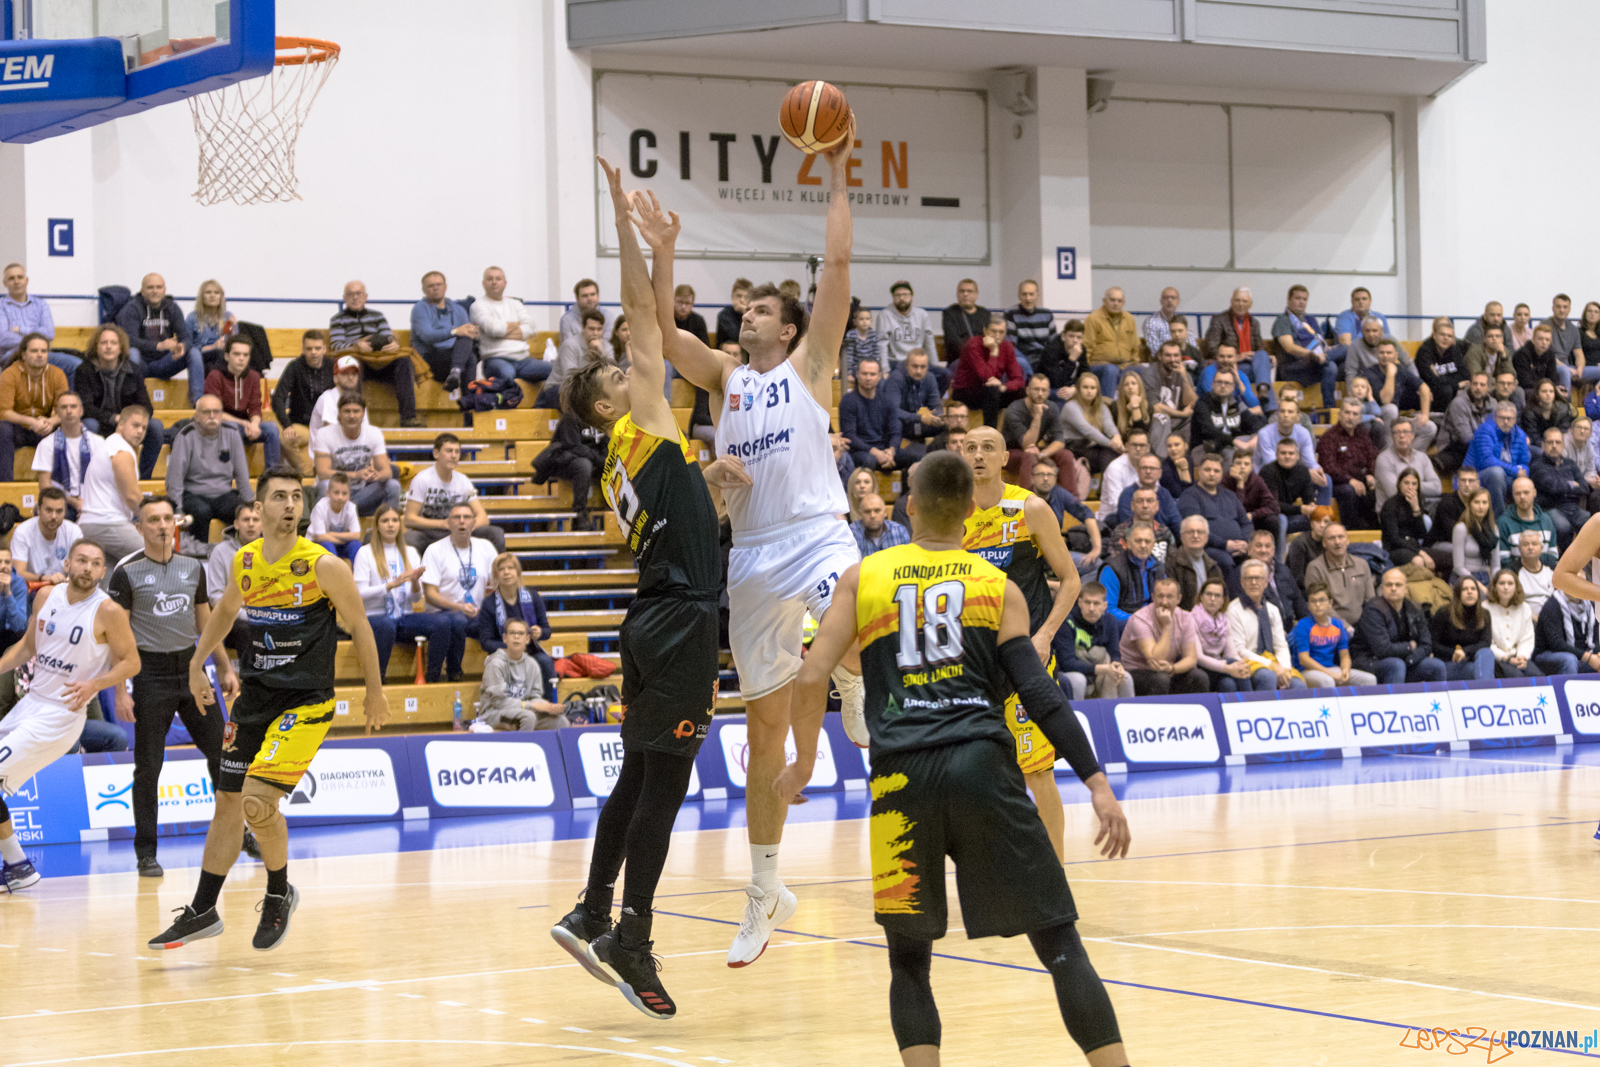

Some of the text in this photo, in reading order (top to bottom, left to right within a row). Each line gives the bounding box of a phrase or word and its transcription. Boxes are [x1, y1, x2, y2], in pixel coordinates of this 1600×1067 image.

[0, 54, 55, 81] EM
[718, 187, 764, 203] WIĘCEJ
[772, 188, 793, 202] NIŻ
[848, 192, 910, 206] PORTOWY
[53, 223, 69, 251] C
[1060, 251, 1073, 275] B
[894, 325, 920, 342] GAP
[766, 378, 790, 409] 31
[1001, 519, 1019, 544] 15
[160, 597, 184, 612] LOTTO
[292, 583, 303, 606] 3
[69, 626, 84, 645] 0
[892, 580, 966, 670] 18
[264, 741, 280, 761] 3
[1018, 732, 1033, 755] 15
[320, 769, 385, 781] DIAGNOSTYKA
[321, 779, 386, 791] OBRAZOWA
